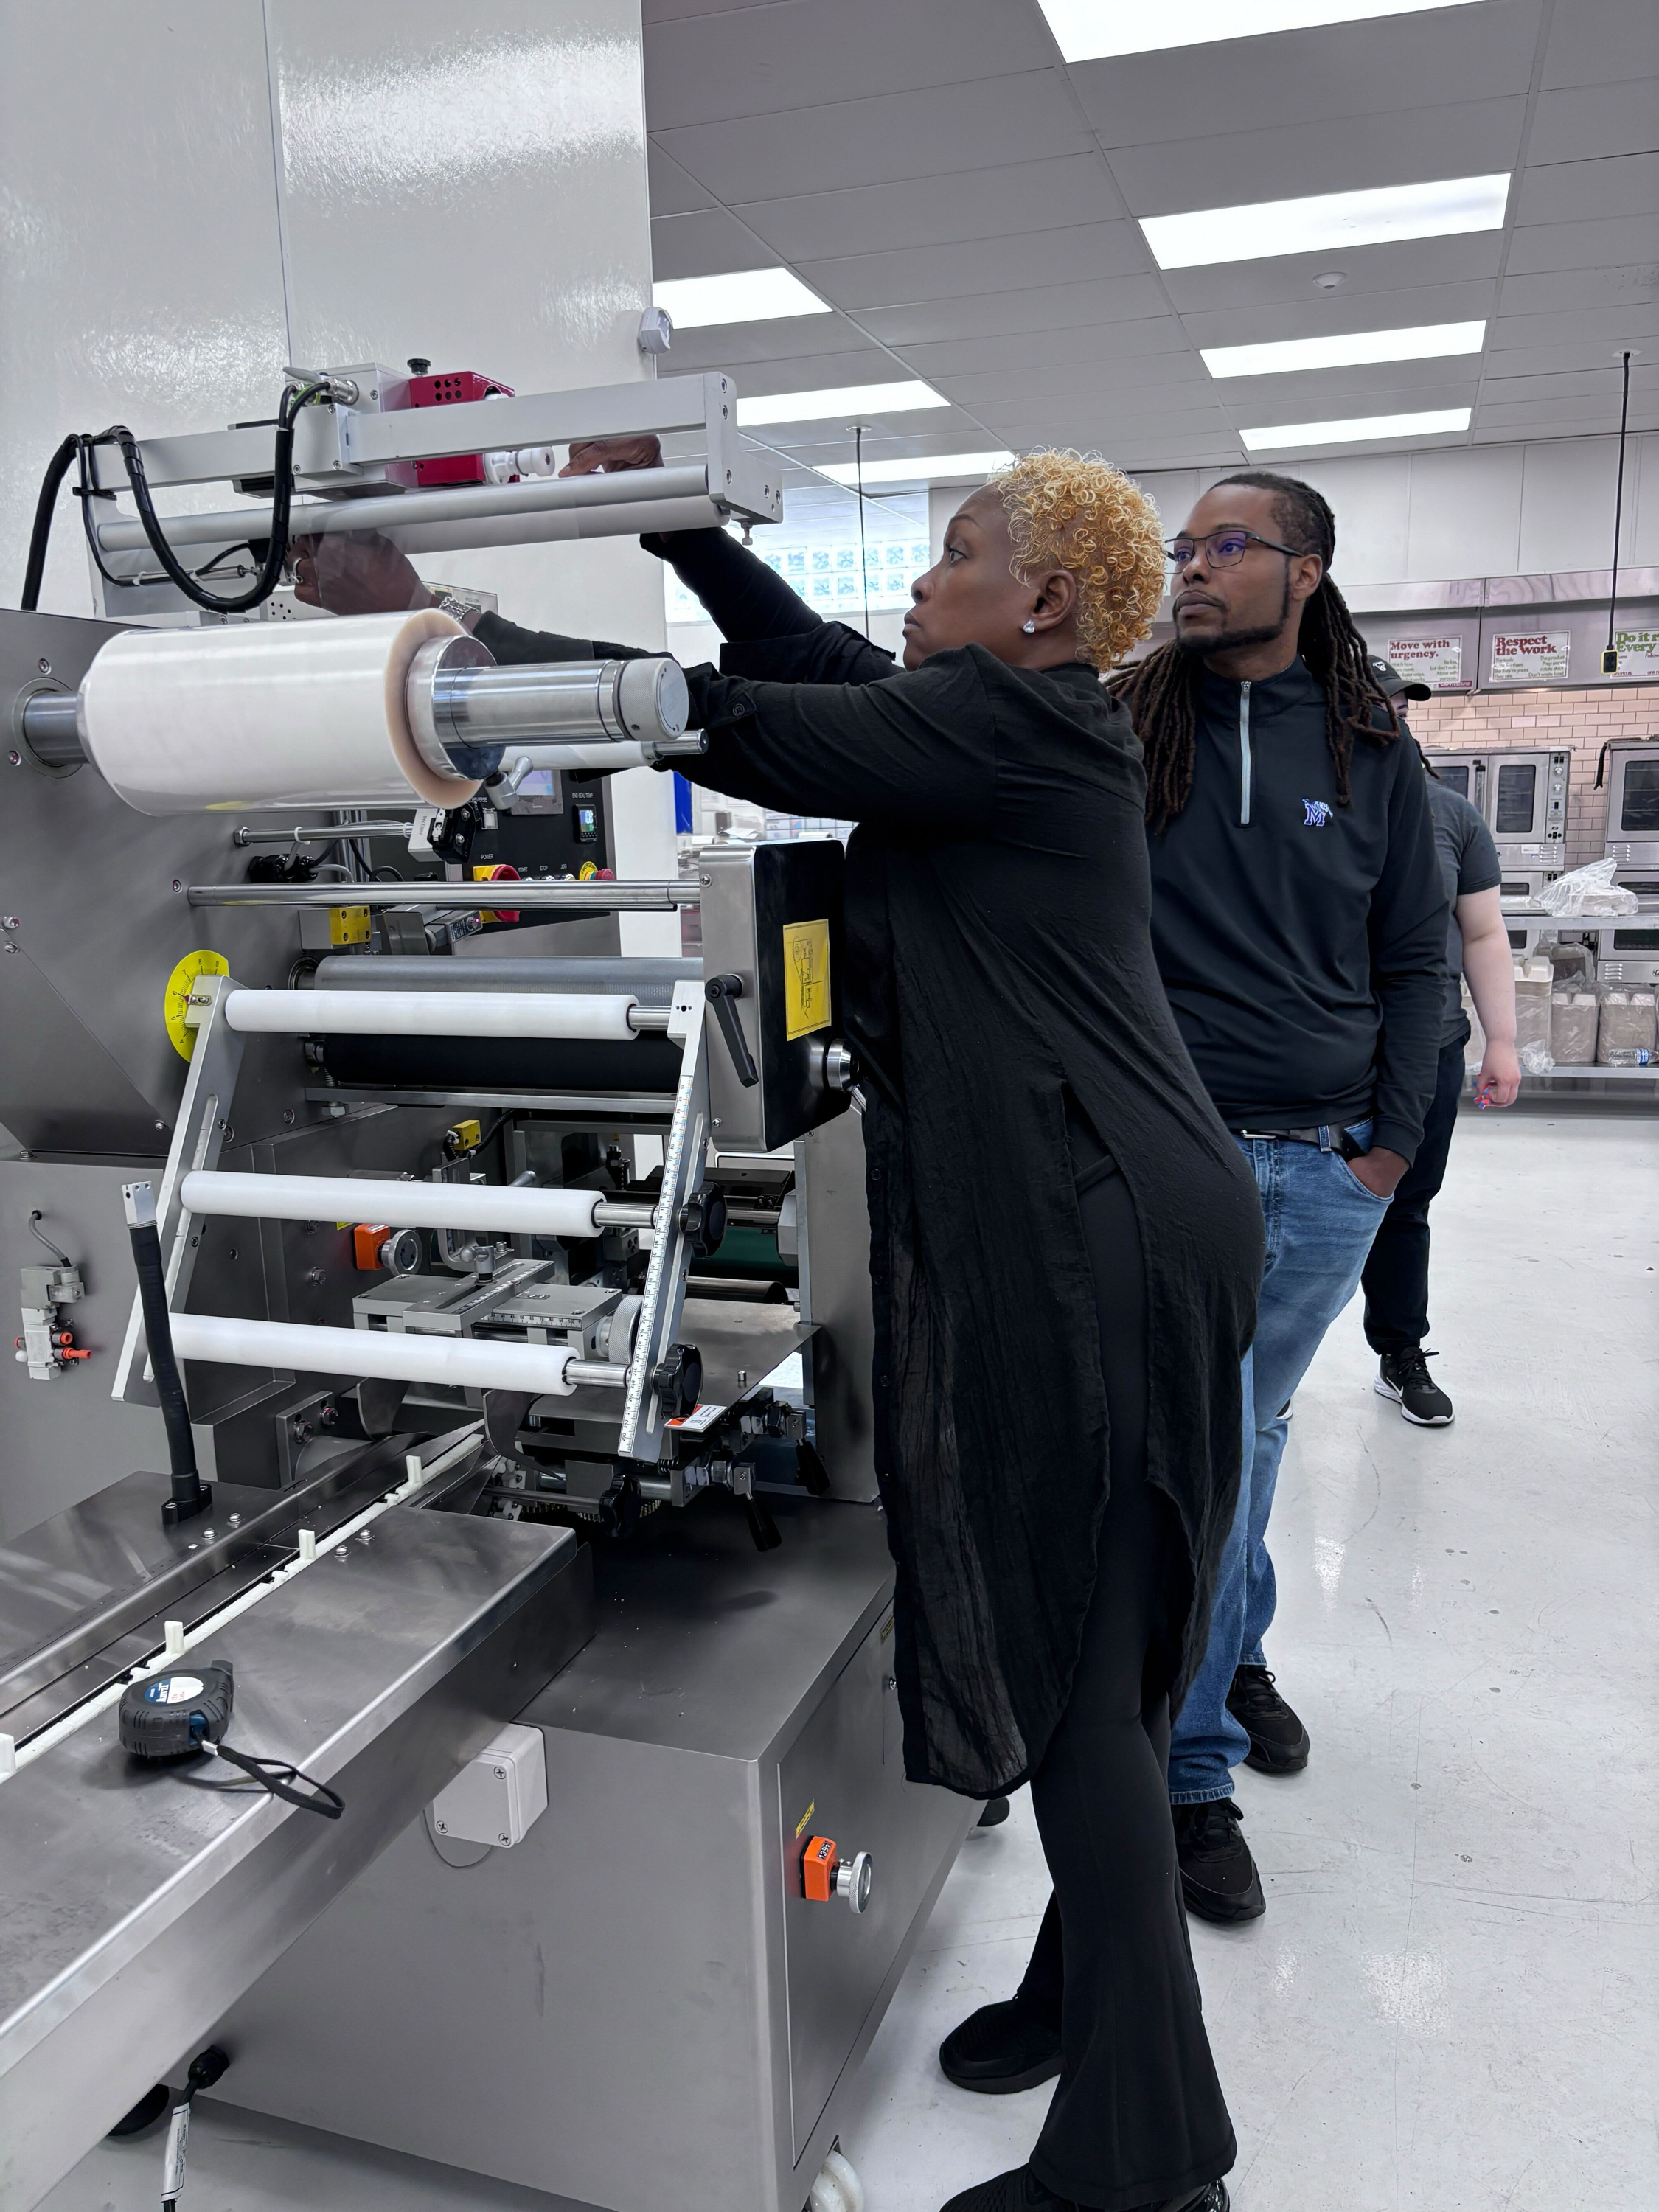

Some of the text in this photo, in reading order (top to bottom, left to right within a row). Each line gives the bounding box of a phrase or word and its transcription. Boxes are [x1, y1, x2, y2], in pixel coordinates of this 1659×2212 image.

[1495, 635, 1548, 648] Respect
[1616, 632, 1636, 643] Do
[1638, 632, 1649, 642] it
[1391, 640, 1450, 650] Move with
[1495, 644, 1557, 655] the work
[1616, 642, 1657, 653] Every
[1390, 651, 1439, 661] urgency.
